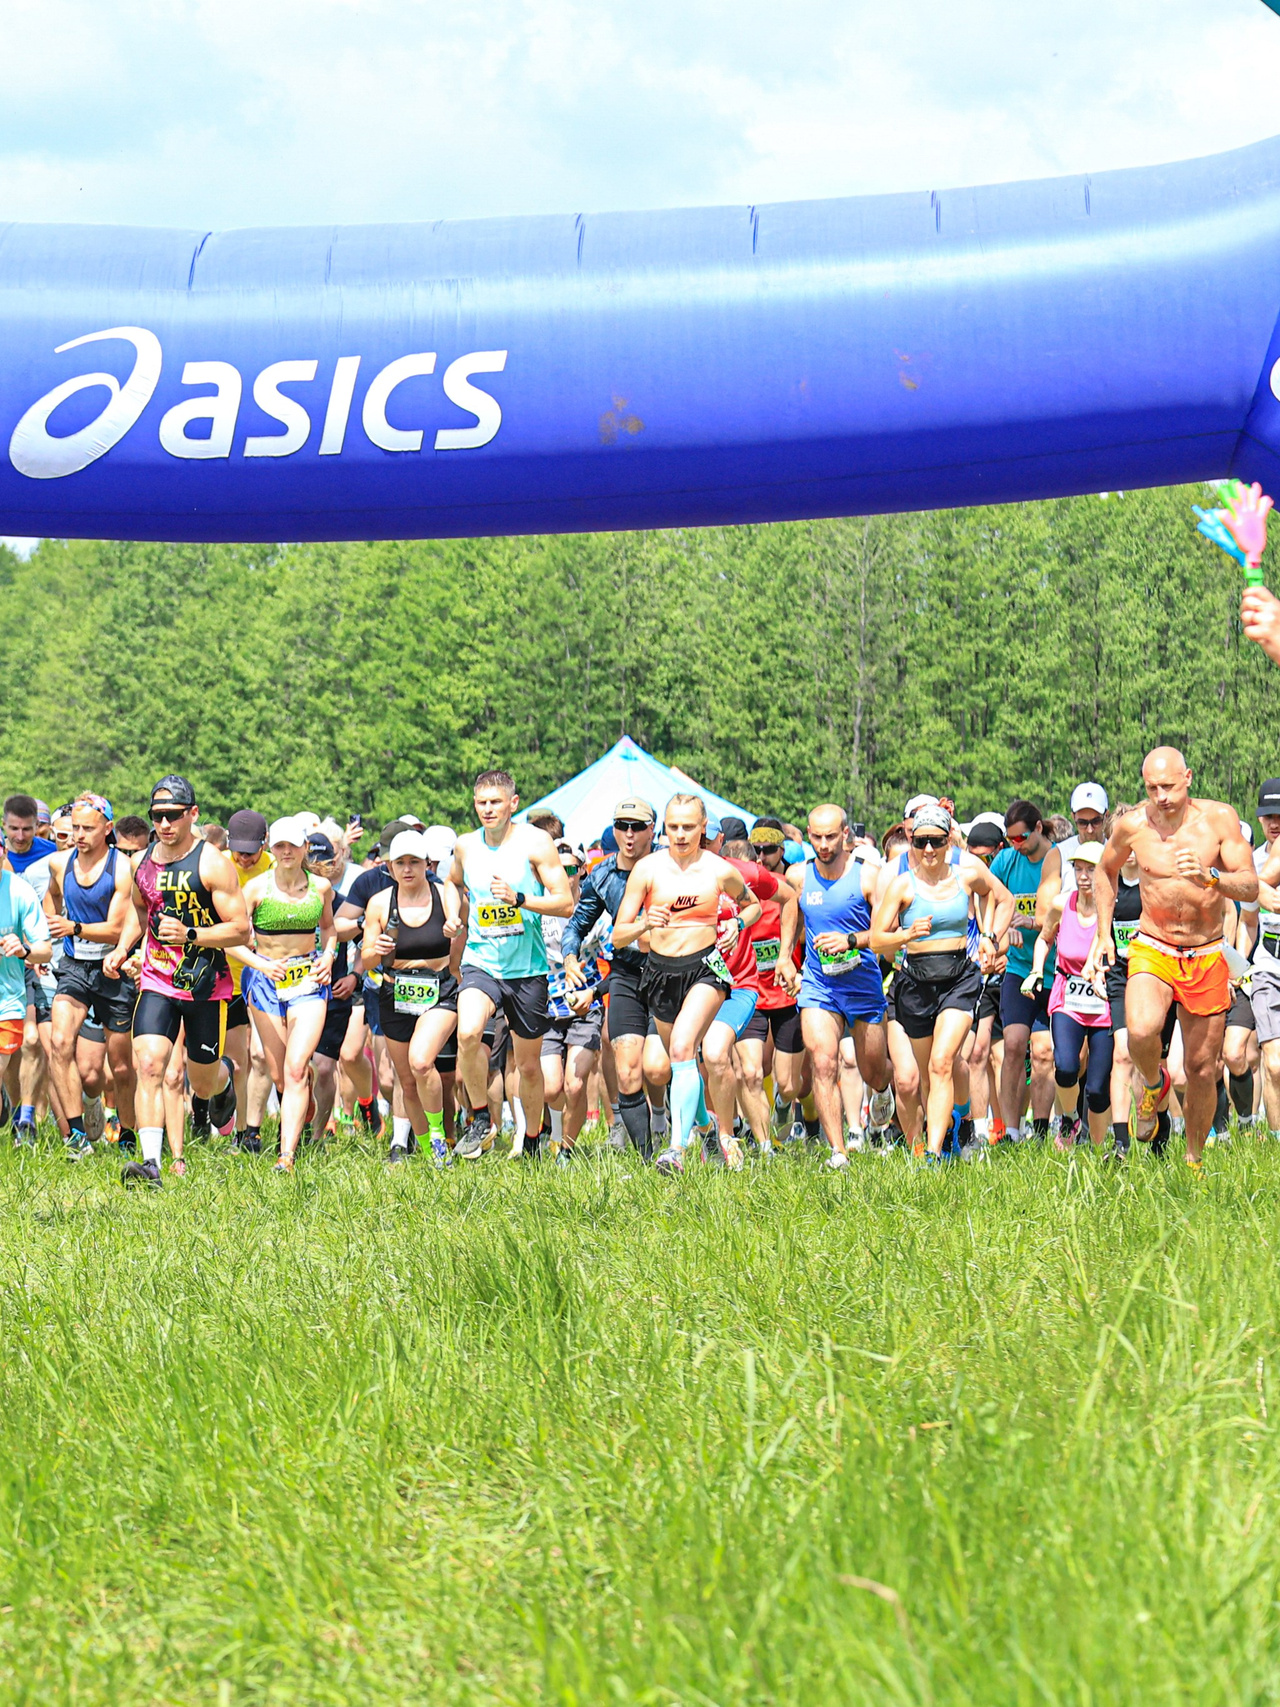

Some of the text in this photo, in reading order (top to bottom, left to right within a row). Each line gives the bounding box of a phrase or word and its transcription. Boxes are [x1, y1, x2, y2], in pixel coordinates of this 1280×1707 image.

[159, 350, 508, 460] asics
[155, 870, 192, 892] ELK
[175, 891, 202, 911] PA
[675, 895, 699, 906] NIKE
[482, 906, 516, 920] 6155
[756, 945, 779, 957] 511
[398, 985, 435, 998] 8536
[1070, 981, 1095, 997] 976
